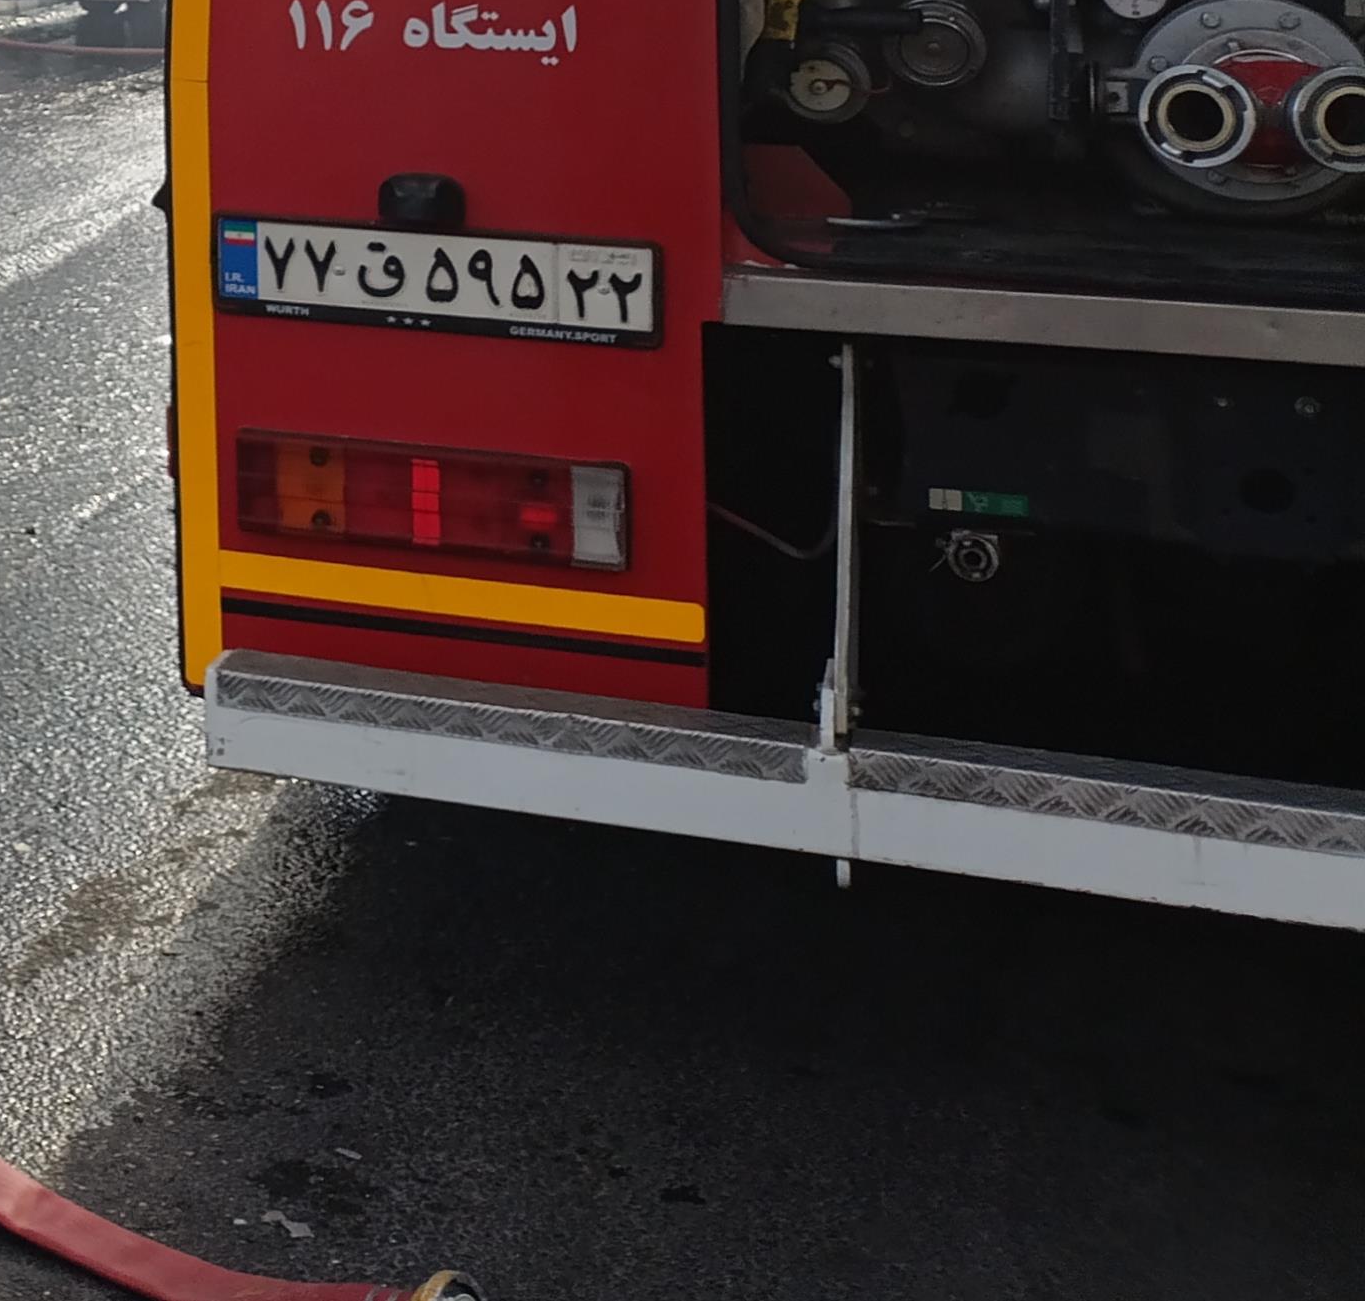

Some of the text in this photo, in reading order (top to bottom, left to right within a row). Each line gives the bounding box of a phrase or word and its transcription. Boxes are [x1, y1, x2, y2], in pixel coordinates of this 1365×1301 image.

[289, 0, 577, 66] ایستگاه ۱۱۶
[224, 283, 256, 295] IRAN
